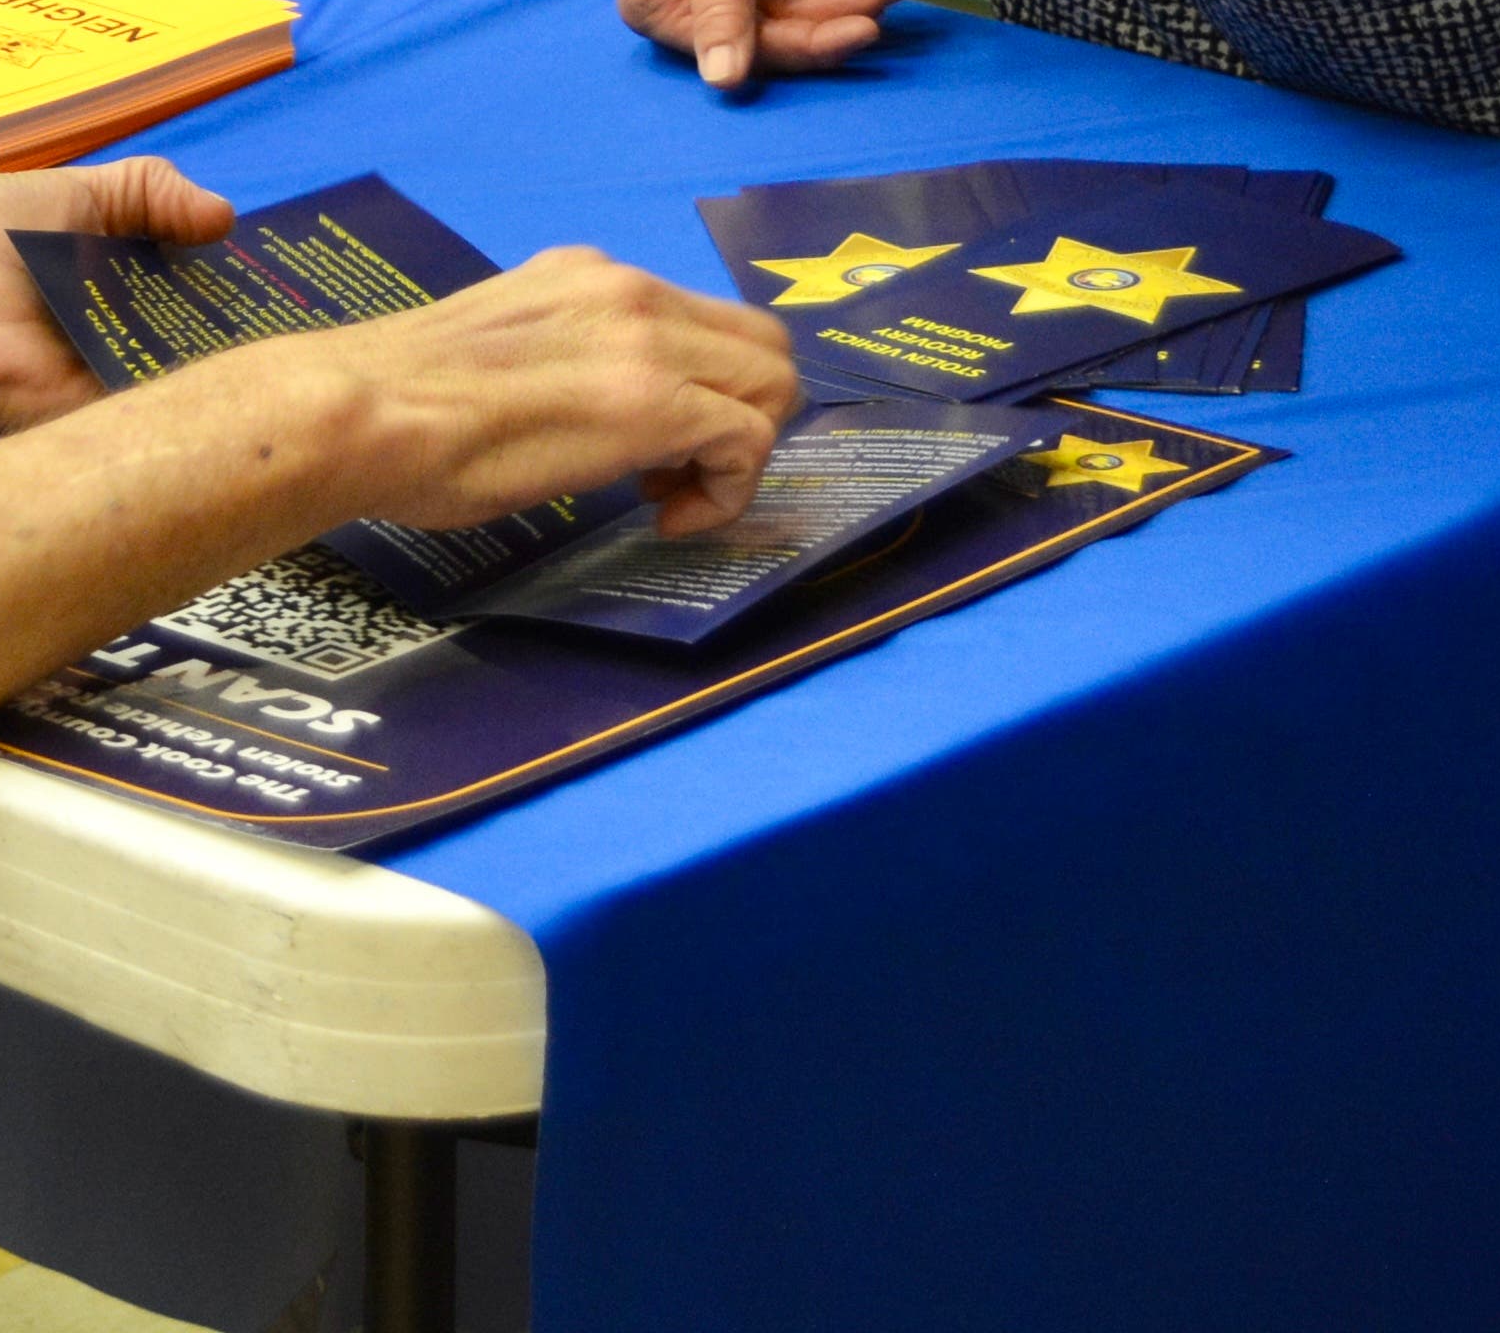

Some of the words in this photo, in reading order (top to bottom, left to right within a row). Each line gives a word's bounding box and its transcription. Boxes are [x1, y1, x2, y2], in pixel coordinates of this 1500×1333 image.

[81, 279, 130, 335] VICTIM
[84, 308, 108, 333] DO
[103, 336, 127, 358] TO
[815, 328, 902, 358] VEHICLE
[871, 327, 985, 361] RECOVERY
[900, 316, 1015, 351] PROGRAM
[900, 352, 987, 378] STOLEN
[91, 636, 160, 669] T
[149, 658, 383, 736] SCAN
[100, 701, 236, 754] Vehicle
[134, 741, 236, 780] Cook
[236, 746, 363, 789] Stolen
[235, 772, 311, 804] The
